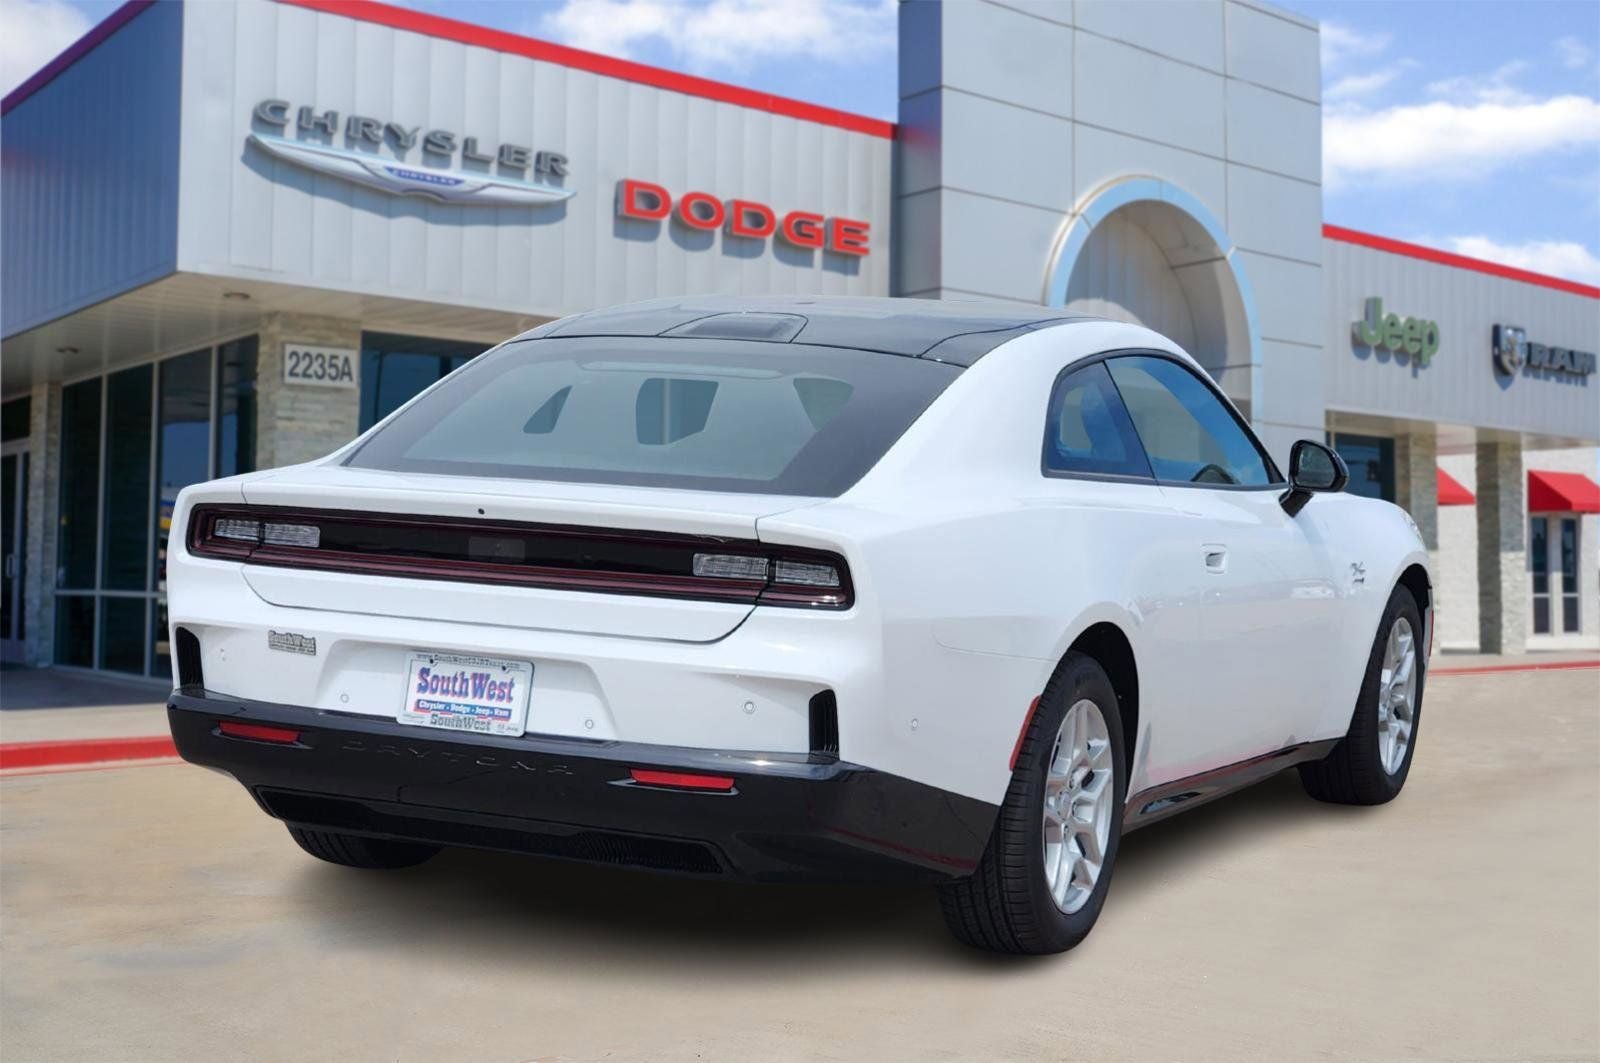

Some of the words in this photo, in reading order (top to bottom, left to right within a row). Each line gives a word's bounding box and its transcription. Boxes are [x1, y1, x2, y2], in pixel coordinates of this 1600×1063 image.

[252, 99, 570, 177] CHRYSLER
[616, 178, 870, 256] DODGE
[1354, 296, 1440, 366] Jeep
[288, 350, 353, 382] 2235A
[1526, 342, 1597, 375] RAM
[416, 666, 515, 704] SouthWest
[418, 700, 447, 712] Chrysler
